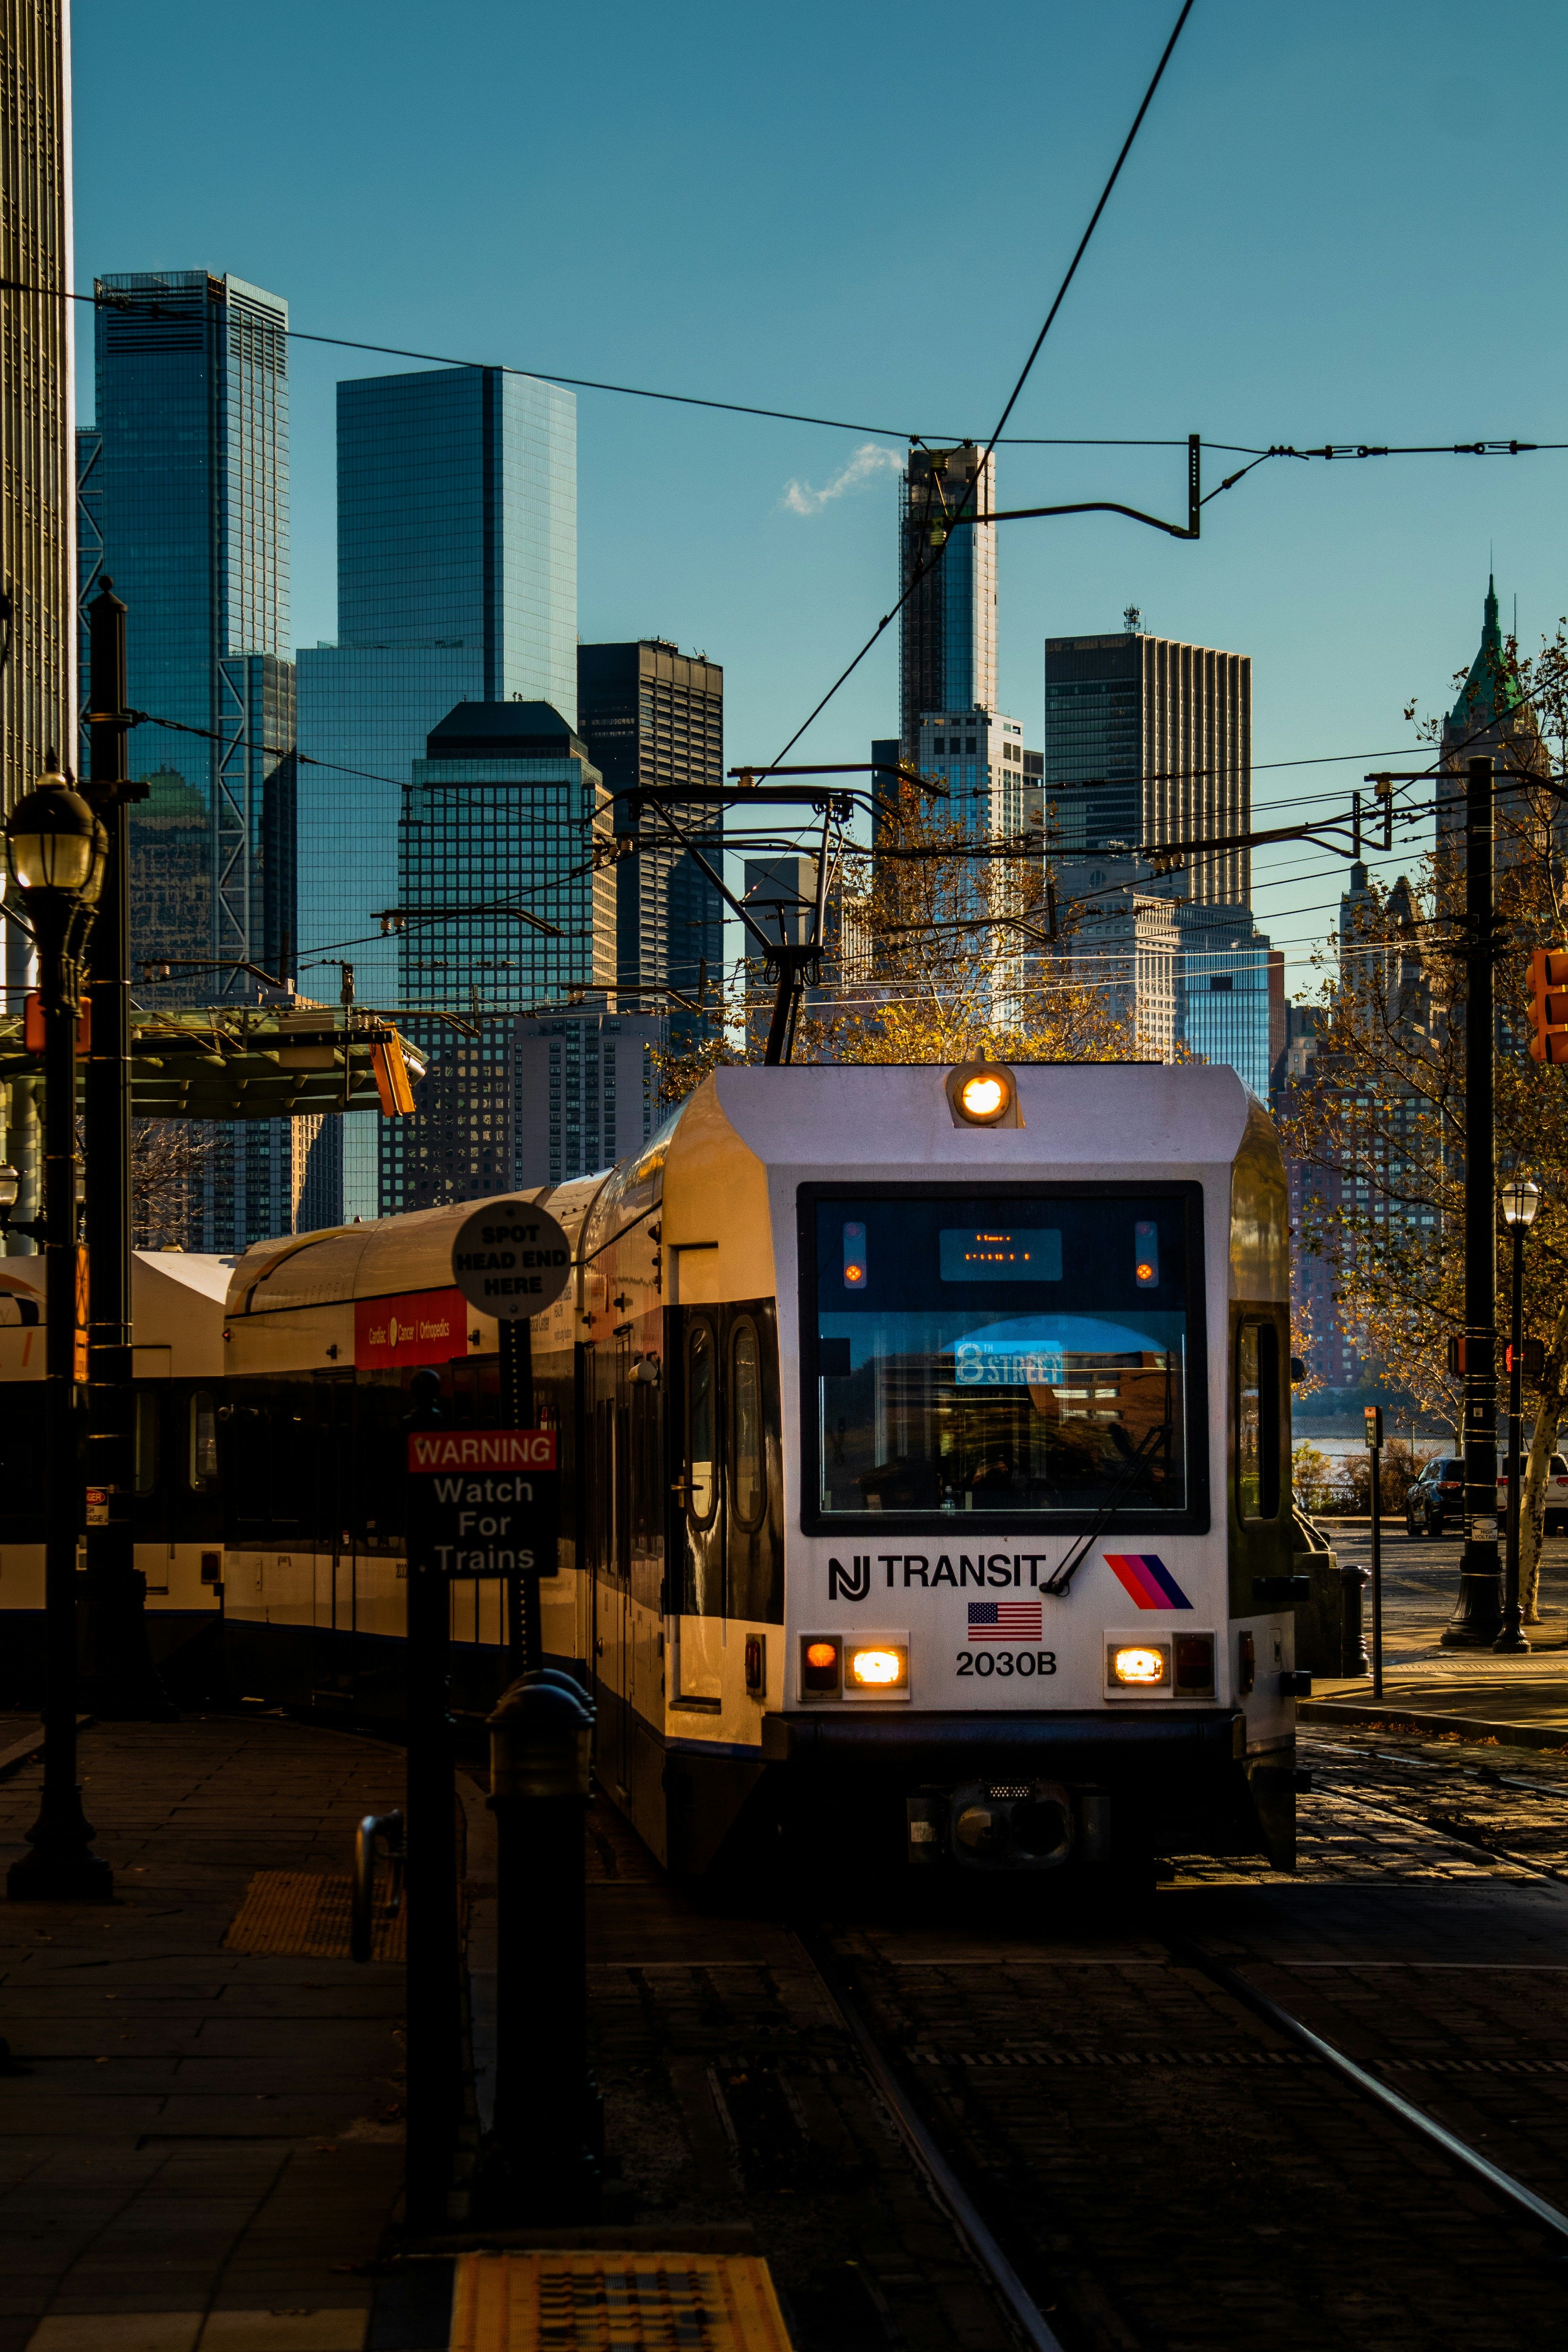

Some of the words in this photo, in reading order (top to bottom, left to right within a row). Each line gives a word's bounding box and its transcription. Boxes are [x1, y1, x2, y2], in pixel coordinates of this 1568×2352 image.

[482, 1224, 540, 1244] SPOT
[457, 1252, 515, 1271] HEAD
[523, 1250, 567, 1268] END
[484, 1277, 543, 1295] HERE
[368, 1326, 387, 1345] Cardiac
[398, 1323, 415, 1341] Cancer
[420, 1318, 450, 1342] Orthopedics
[987, 1355, 1061, 1383] STREET
[415, 1436, 552, 1466] WARNING
[433, 1476, 534, 1504] Watch
[458, 1511, 512, 1536] For
[434, 1544, 536, 1572] Trains
[829, 1556, 870, 1601] NJ
[878, 1555, 1046, 1587] TRANSIT
[956, 1651, 1057, 1676] 2030B
